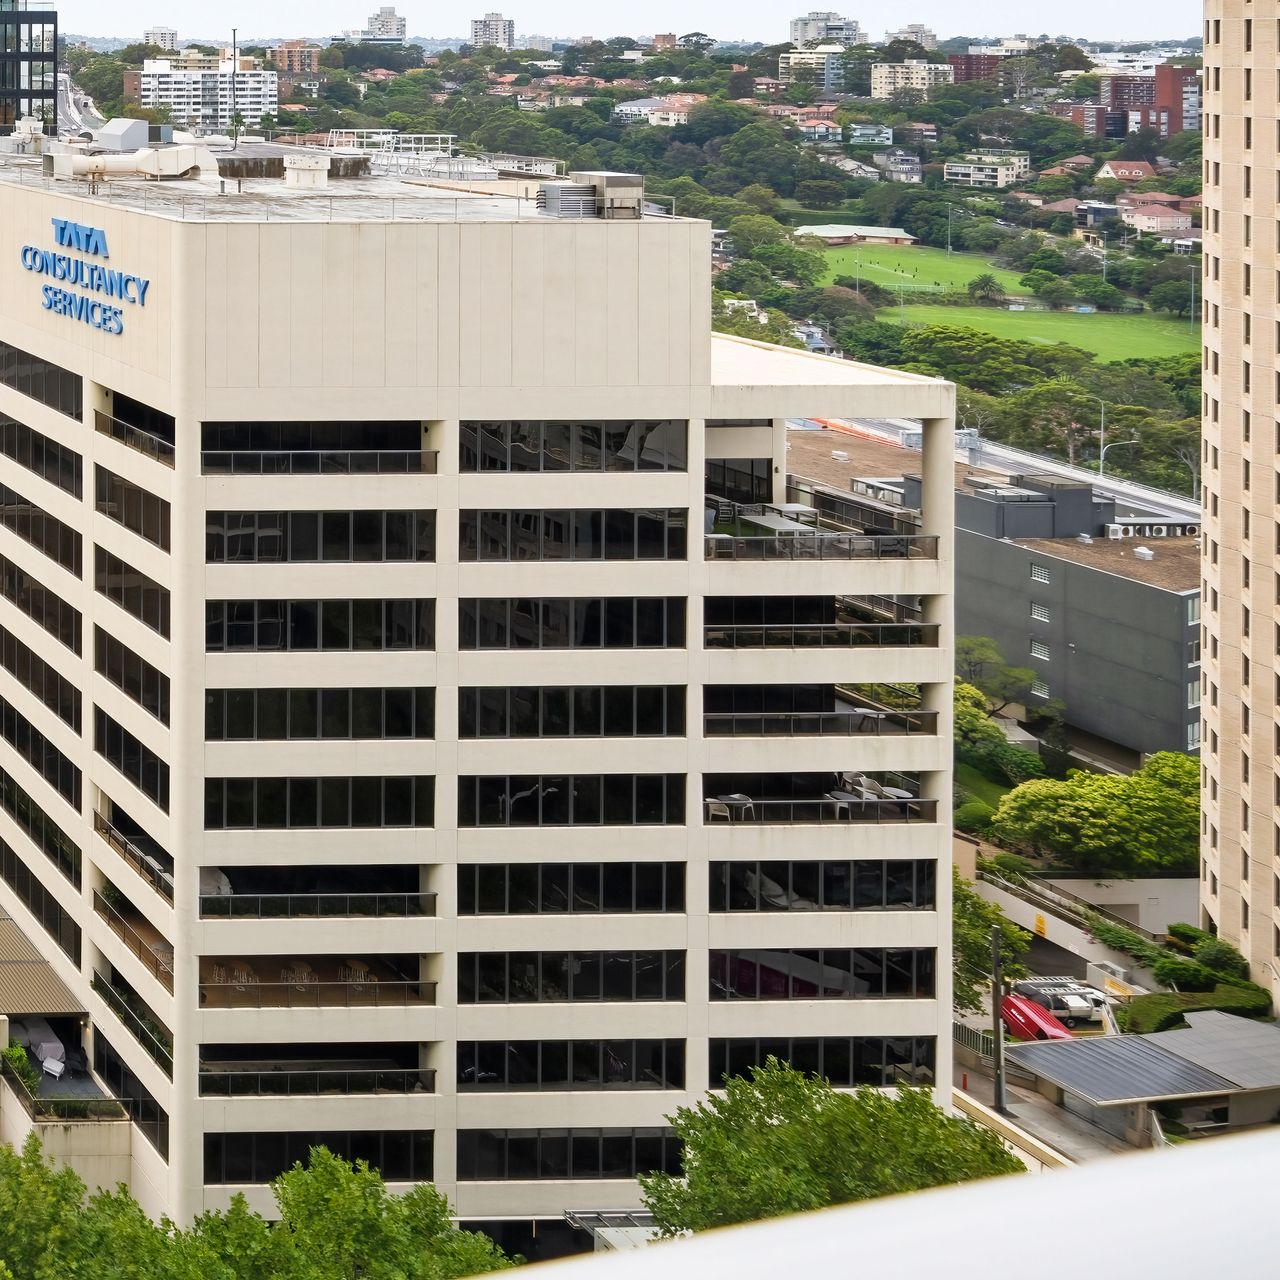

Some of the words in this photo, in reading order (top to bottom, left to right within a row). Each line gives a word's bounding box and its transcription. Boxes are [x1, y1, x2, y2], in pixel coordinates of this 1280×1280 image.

[51, 217, 110, 259] TATA
[21, 245, 150, 307] CONSULTANCY
[42, 283, 124, 335] SERVICES
